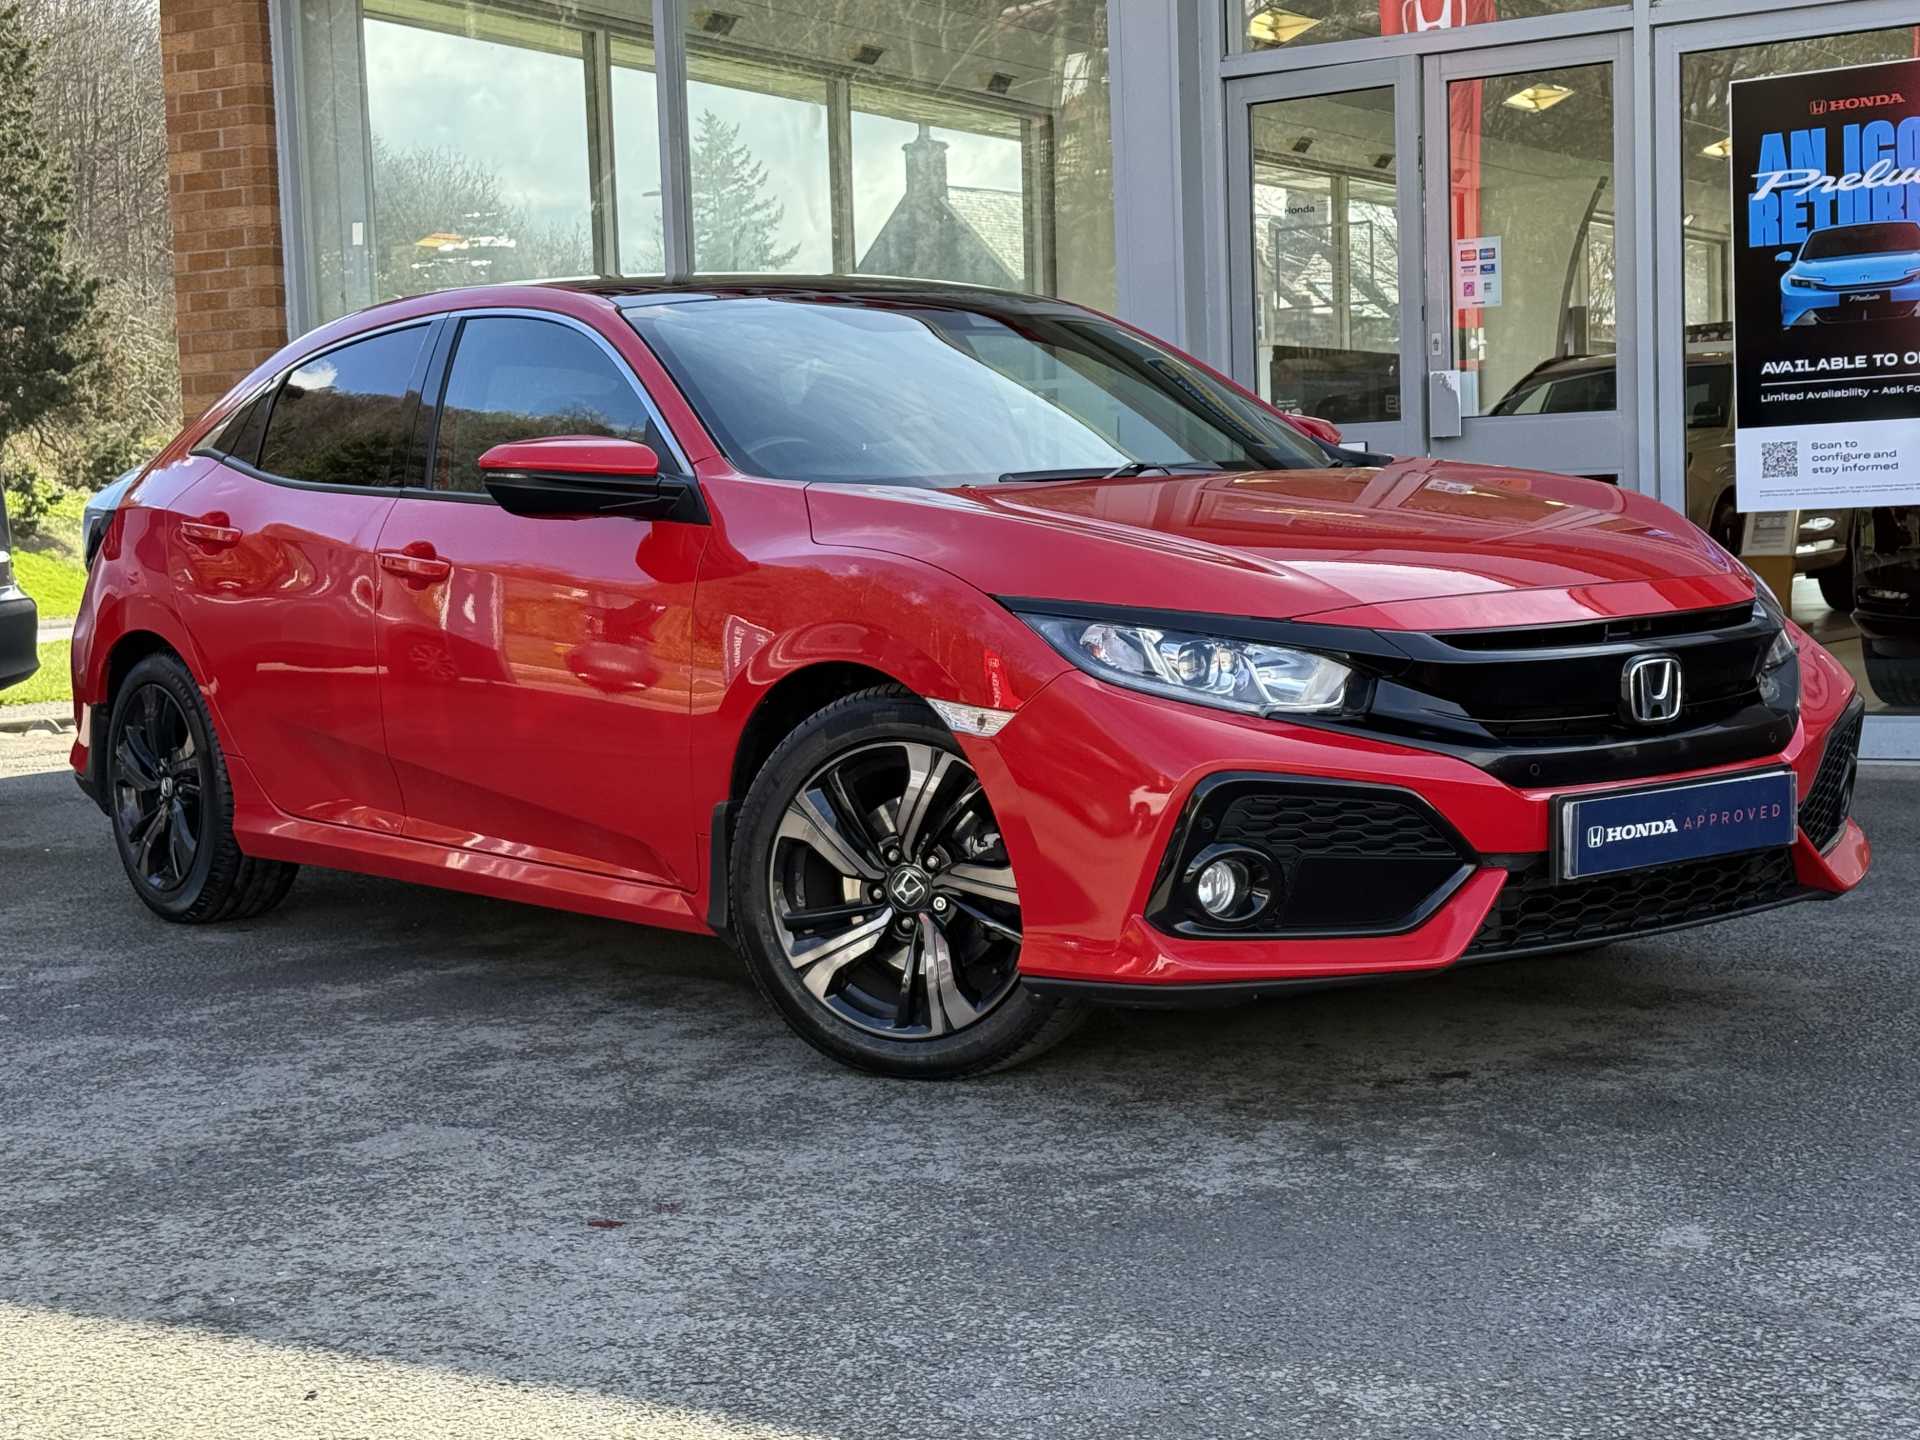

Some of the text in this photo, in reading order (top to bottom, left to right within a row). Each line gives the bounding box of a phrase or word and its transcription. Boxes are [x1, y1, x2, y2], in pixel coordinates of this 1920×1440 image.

[1829, 93, 1905, 111] HONDA
[1757, 128, 1827, 189] AN
[1751, 158, 1920, 200] Prelu
[1761, 355, 1867, 375] AVAILABLE
[1872, 353, 1898, 367] TO
[1761, 391, 1804, 403] Limited
[1806, 387, 1870, 398] Availability
[1881, 385, 1904, 394] Ask
[1811, 442, 1842, 450] Scan
[1811, 450, 1897, 463] configure and
[1811, 462, 1899, 475] stay informed
[1606, 818, 1679, 842] HONDA
[1683, 803, 1782, 831] APPROVED
